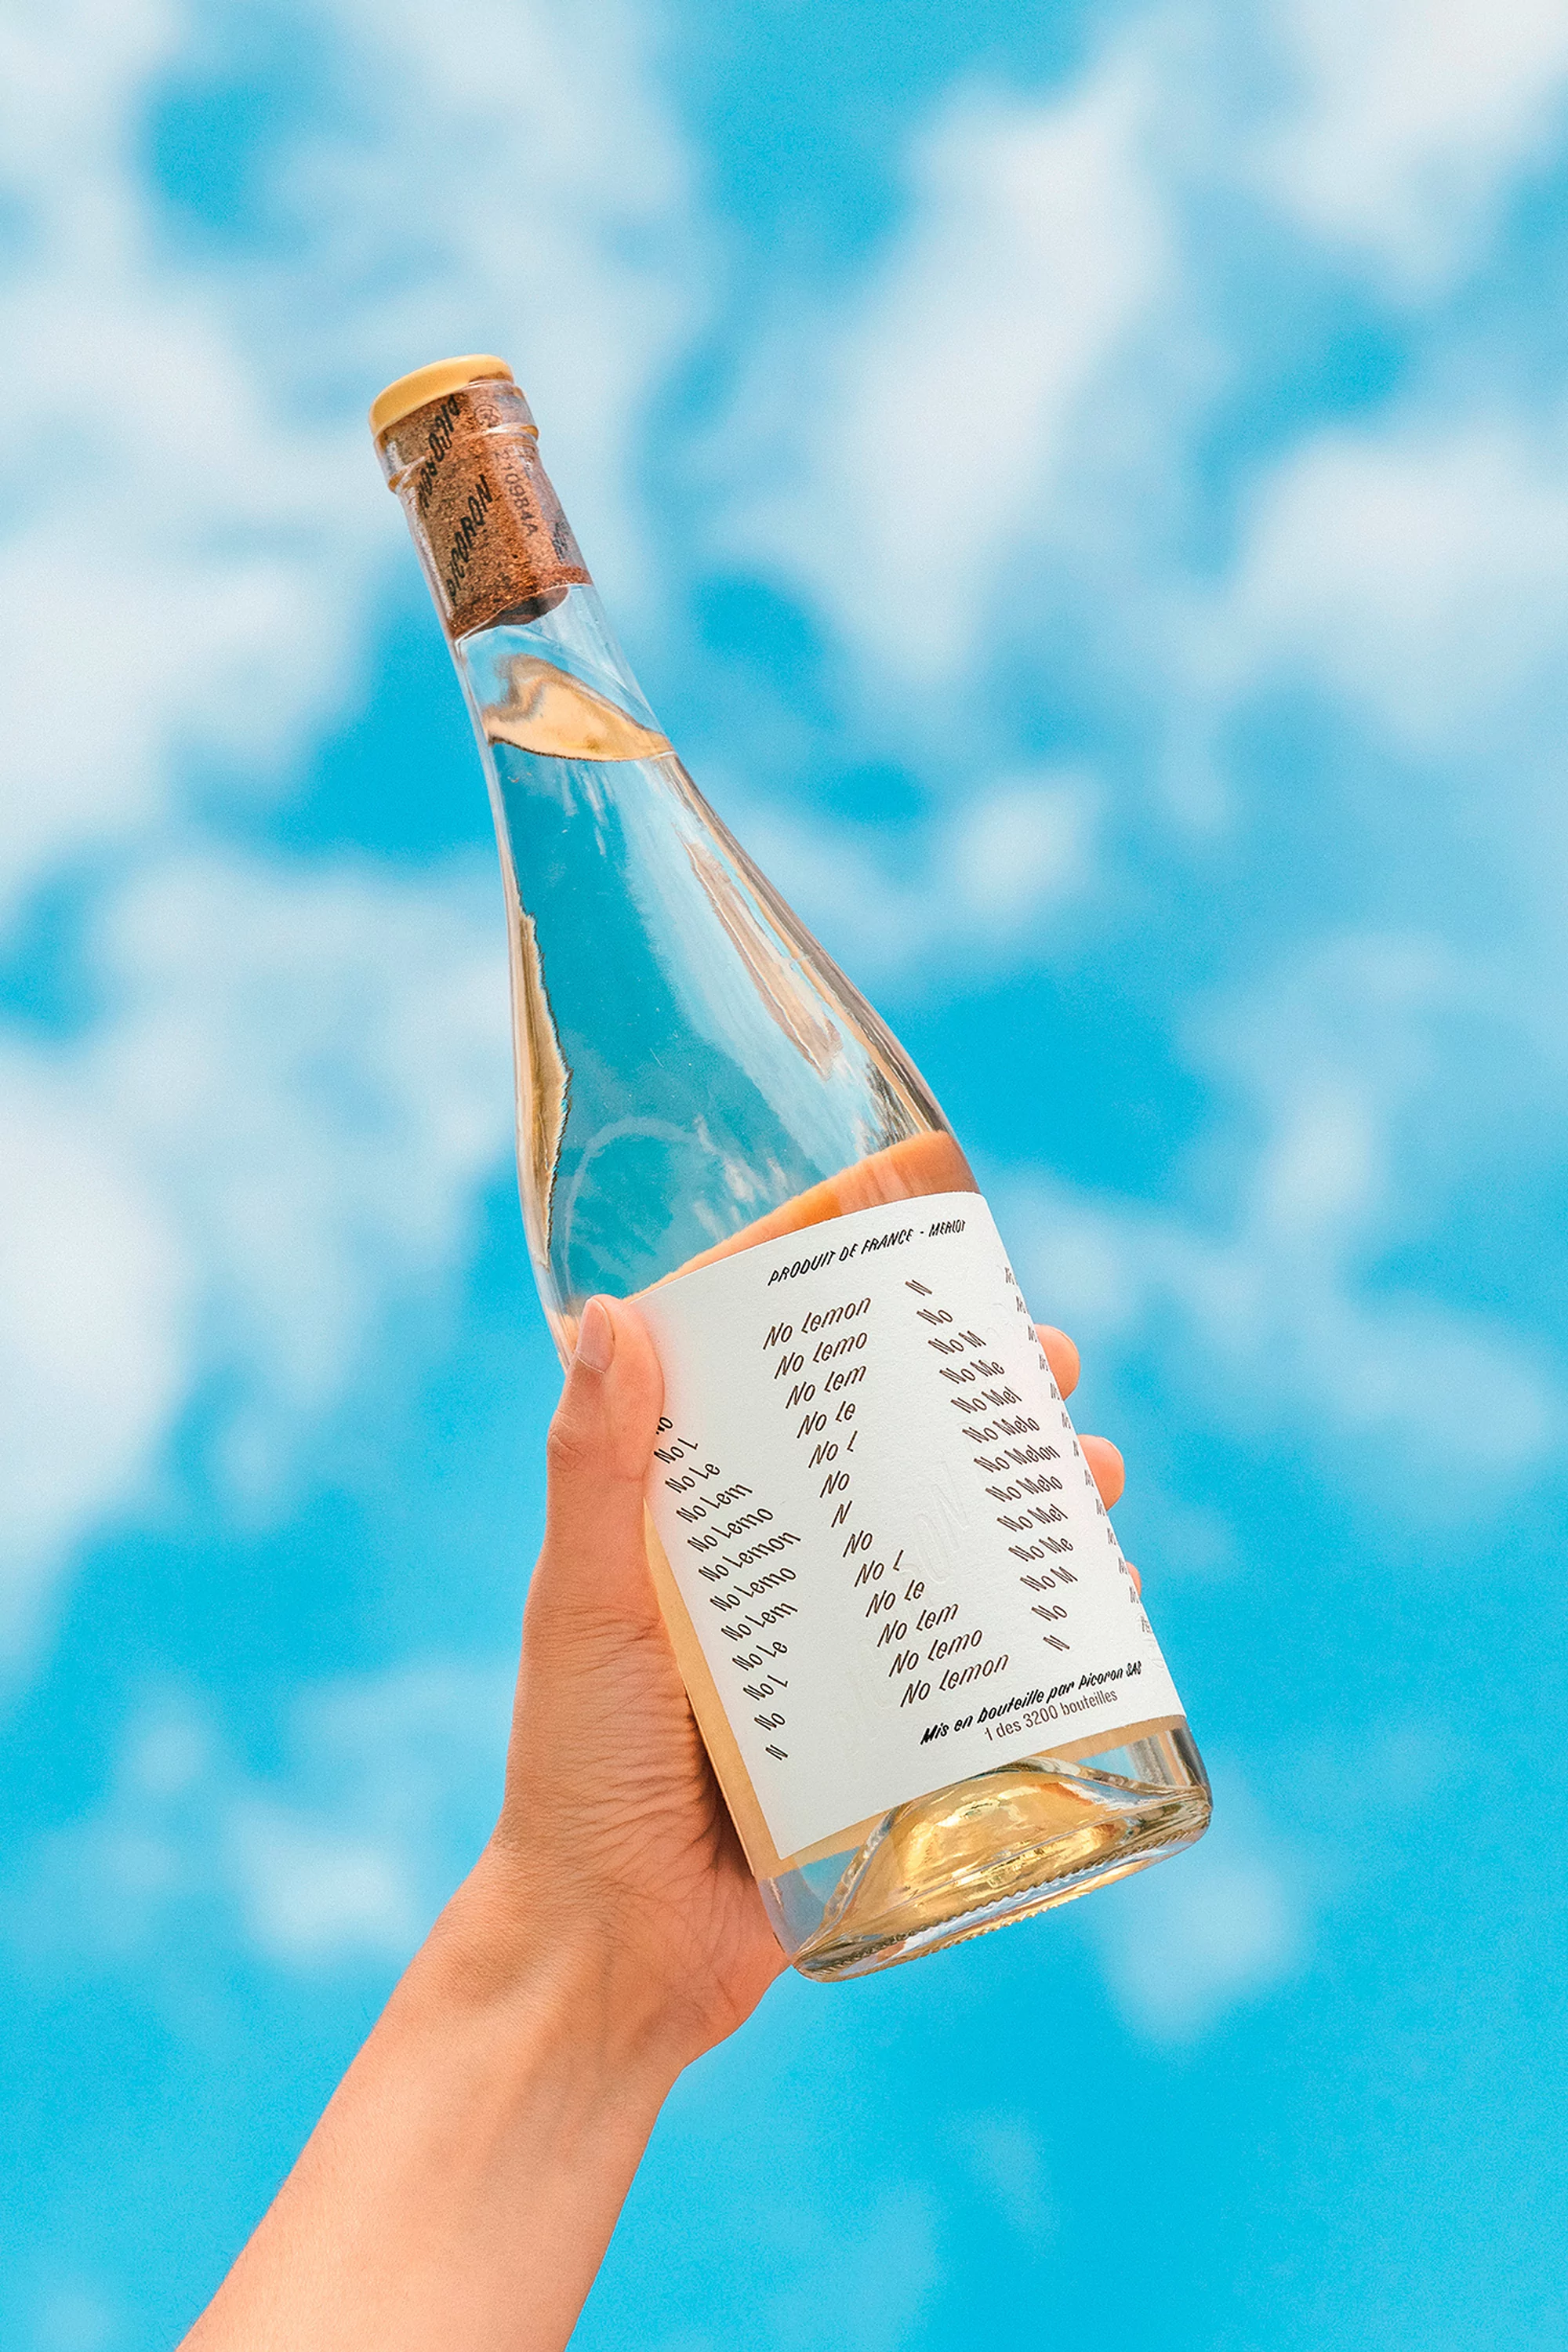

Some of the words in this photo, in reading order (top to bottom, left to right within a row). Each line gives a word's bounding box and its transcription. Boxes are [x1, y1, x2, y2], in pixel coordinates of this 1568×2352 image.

[446, 473, 493, 606] PICORON
[767, 1250, 837, 1287] PRODUIT
[838, 1243, 859, 1262] DE
[860, 1228, 914, 1255] FRANCE
[927, 1218, 966, 1238] MERLOT
[904, 1279, 933, 1297] N
[762, 1322, 793, 1351] No
[800, 1297, 872, 1334] Lemon
[916, 1308, 953, 1327] No
[773, 1352, 804, 1380] No
[812, 1332, 868, 1363] Lemo
[927, 1338, 965, 1356] No
[957, 1330, 987, 1348] M
[938, 1367, 976, 1385] No
[969, 1359, 1005, 1377] Me
[785, 1381, 816, 1410] No
[823, 1365, 867, 1393] Lem
[949, 1396, 988, 1414] No
[980, 1385, 1023, 1406] Mel
[796, 1410, 828, 1439] No
[834, 1400, 856, 1423] Le
[961, 1426, 999, 1444] No
[992, 1414, 1040, 1436] Melo
[653, 1446, 685, 1465] No
[677, 1437, 699, 1450] L
[808, 1440, 839, 1469] No
[846, 1430, 858, 1453] L
[973, 1456, 1011, 1473] No
[1004, 1444, 1061, 1466] Melon
[664, 1475, 696, 1494] No
[688, 1463, 720, 1480] Le
[818, 1470, 851, 1499] No
[985, 1485, 1022, 1503] No
[1015, 1473, 1063, 1495] Melo
[675, 1504, 707, 1523] No
[699, 1483, 753, 1510] Lem
[830, 1500, 853, 1529] N
[996, 1515, 1034, 1533] No
[1026, 1503, 1069, 1525] Mel
[687, 1534, 719, 1553] No
[710, 1508, 774, 1540] Lemo
[842, 1530, 873, 1559] No
[698, 1563, 730, 1583] No
[721, 1532, 802, 1569] Lemon
[1007, 1544, 1045, 1563] No
[1038, 1536, 1074, 1555] Me
[854, 1559, 885, 1588] No
[892, 1548, 905, 1572] L
[1019, 1574, 1057, 1592] No
[1050, 1566, 1079, 1584] M
[709, 1593, 741, 1612] No
[733, 1567, 797, 1599] Lemo
[865, 1589, 896, 1618] No
[903, 1579, 925, 1602] Le
[720, 1623, 752, 1642] No
[744, 1602, 798, 1628] Lem
[876, 1619, 908, 1648] No
[915, 1603, 959, 1632] Lem
[1030, 1604, 1068, 1622] No
[731, 1653, 764, 1671] No
[755, 1641, 788, 1658] Le
[887, 1649, 920, 1678] No
[927, 1629, 983, 1662] Lemo
[1042, 1634, 1070, 1652] N
[742, 1682, 775, 1701] No
[767, 1674, 789, 1688] L
[899, 1679, 931, 1708] No
[938, 1653, 1009, 1692] Lemon
[920, 1722, 950, 1746] Mis
[953, 1715, 974, 1733] en
[976, 1688, 1045, 1724] bouteille
[1045, 1680, 1076, 1704] par
[1125, 1660, 1142, 1678] SAS
[984, 1726, 993, 1741] 1
[996, 1720, 1022, 1738] des
[1022, 1704, 1058, 1729] 3200
[1059, 1690, 1118, 1716] bouteilles
[753, 1712, 786, 1732] No
[764, 1744, 789, 1761] N
